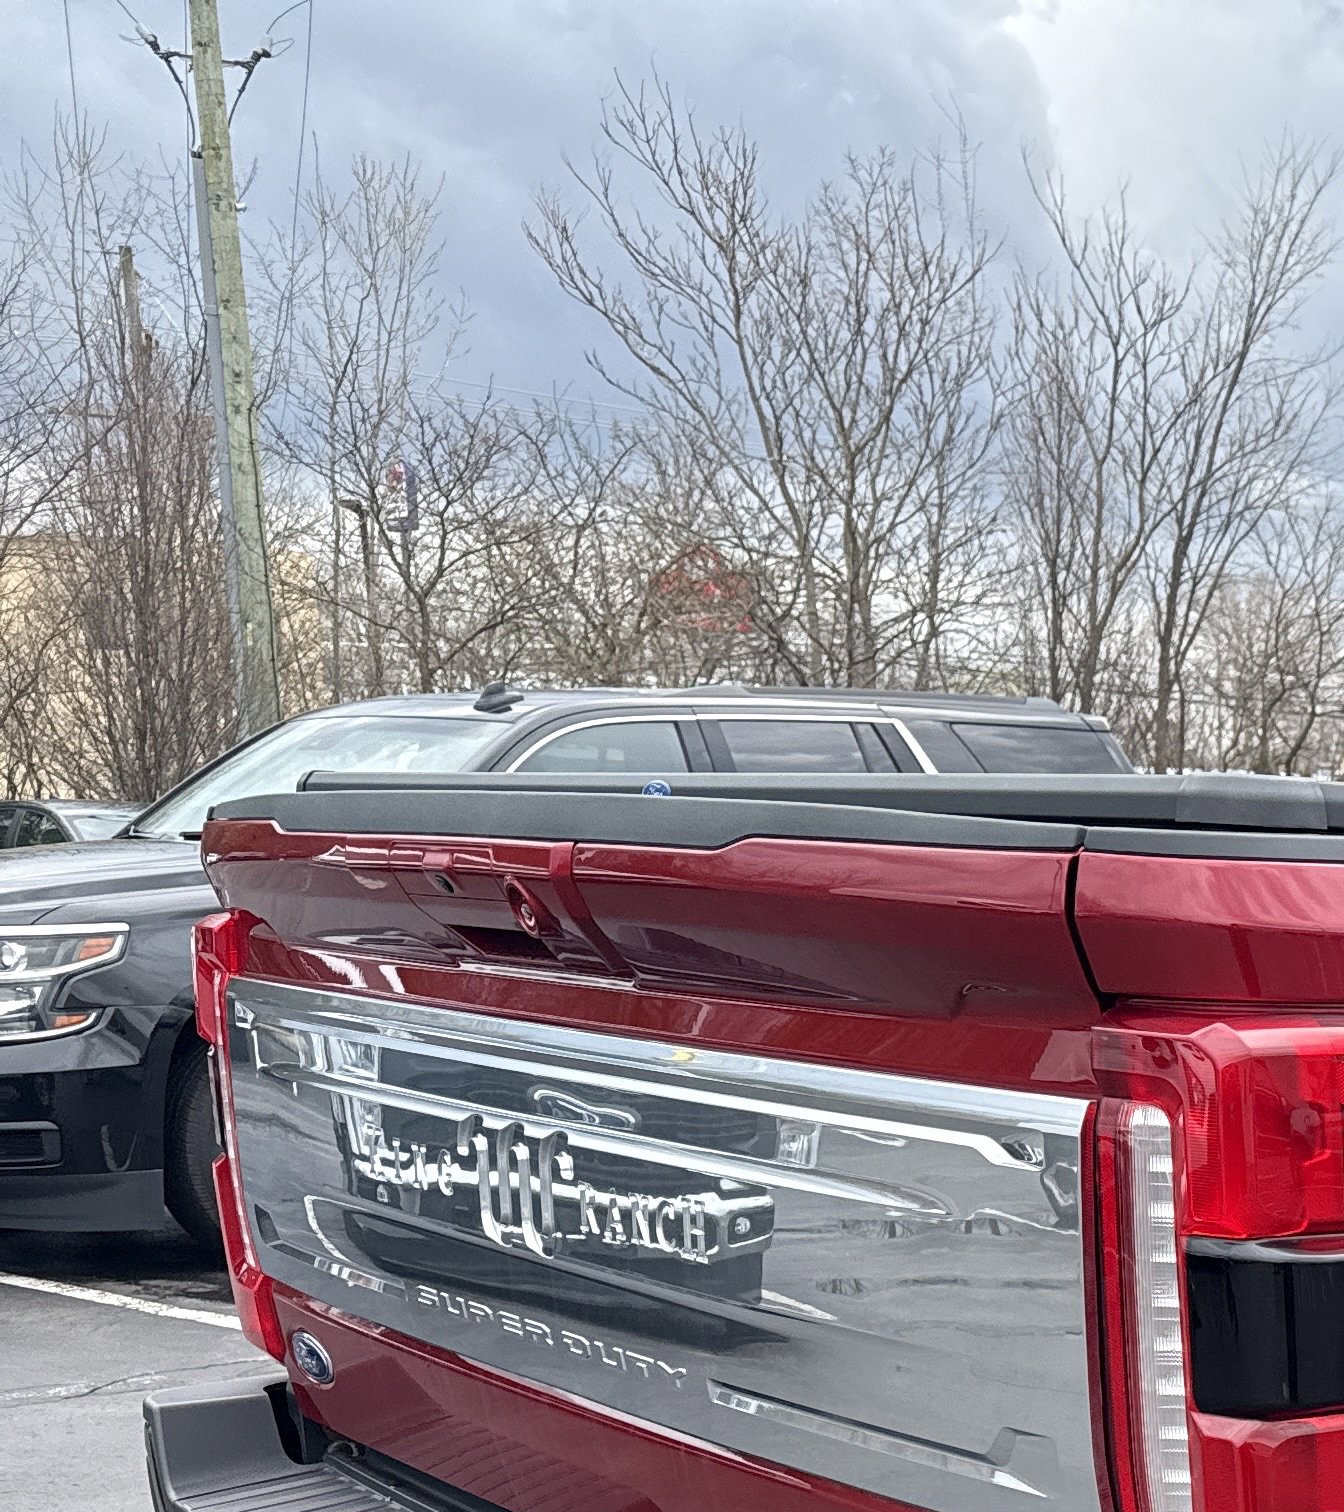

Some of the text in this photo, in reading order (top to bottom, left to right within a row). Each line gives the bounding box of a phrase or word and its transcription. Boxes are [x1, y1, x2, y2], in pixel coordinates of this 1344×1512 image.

[577, 1179, 710, 1264] RANCH
[415, 1283, 688, 1389] SUPER DUTY
